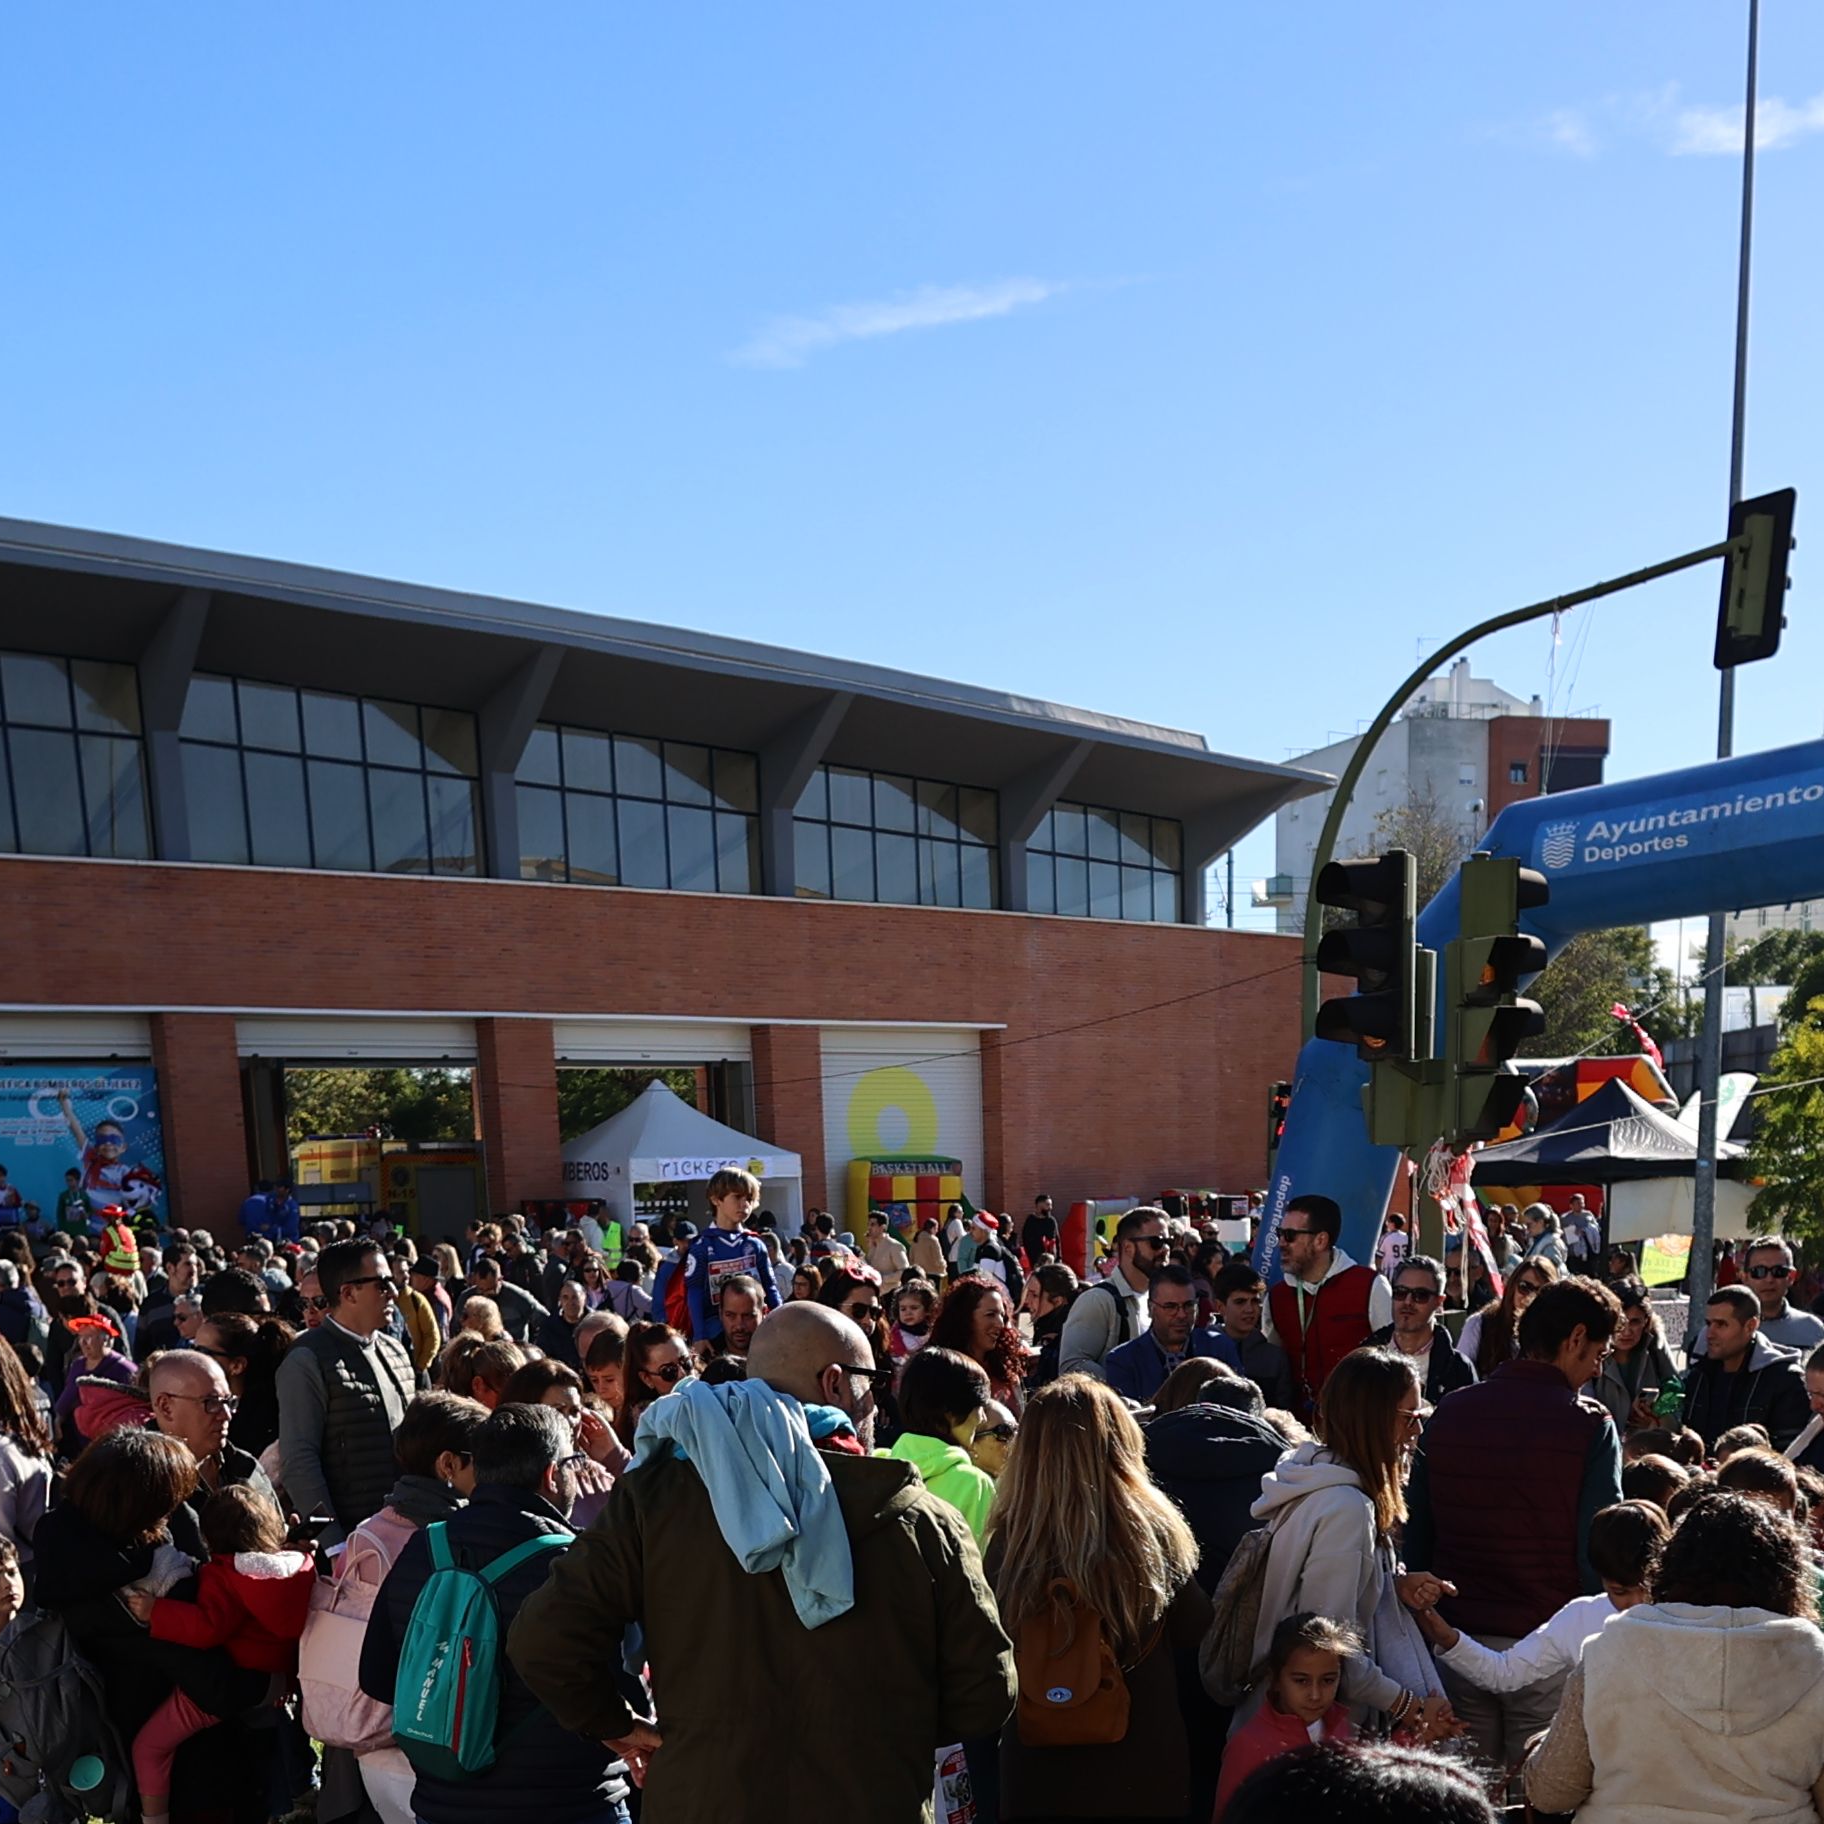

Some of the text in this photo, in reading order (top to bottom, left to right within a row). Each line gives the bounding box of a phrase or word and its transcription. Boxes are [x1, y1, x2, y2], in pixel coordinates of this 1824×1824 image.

[1586, 784, 1824, 842] Ayuntamiento
[1584, 834, 1689, 863] Deportes
[562, 1162, 609, 1181] BEROS
[872, 1162, 952, 1176] BASKETBALL
[416, 1657, 445, 1722] MANUEL
